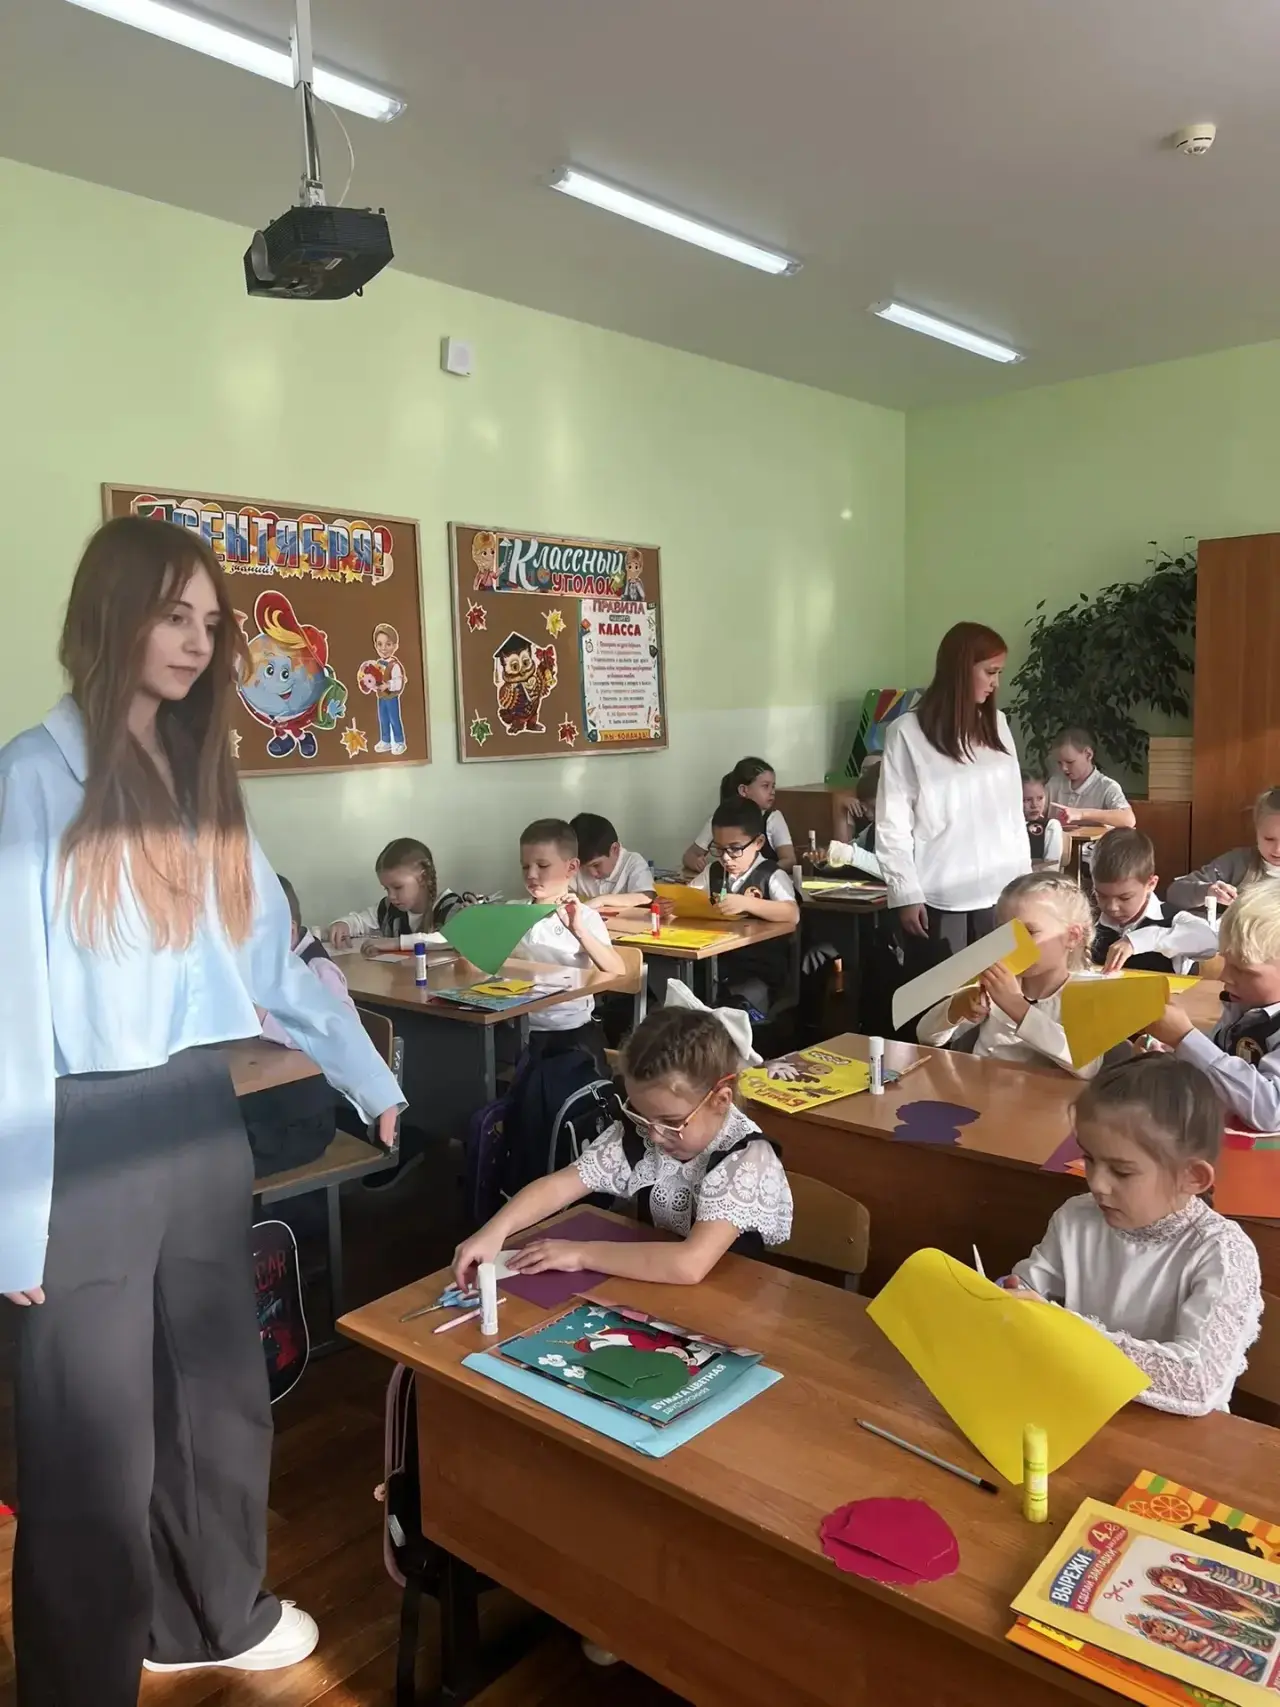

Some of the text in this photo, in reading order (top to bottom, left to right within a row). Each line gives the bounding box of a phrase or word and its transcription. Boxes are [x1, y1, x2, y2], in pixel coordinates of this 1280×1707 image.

[551, 572, 616, 596] УГОЛОК
[592, 600, 646, 615] ПРАВИЛА
[598, 623, 642, 636] КЛАССА
[686, 1363, 727, 1392] ЦВЕТНАЯ
[1091, 1528, 1110, 1542] 4
[1051, 1552, 1093, 1603] ВЫРЕЖИ
[1077, 1579, 1095, 1604] СДЕЛАЙ
[1087, 1548, 1118, 1581] ЗАКЛАДКИ
